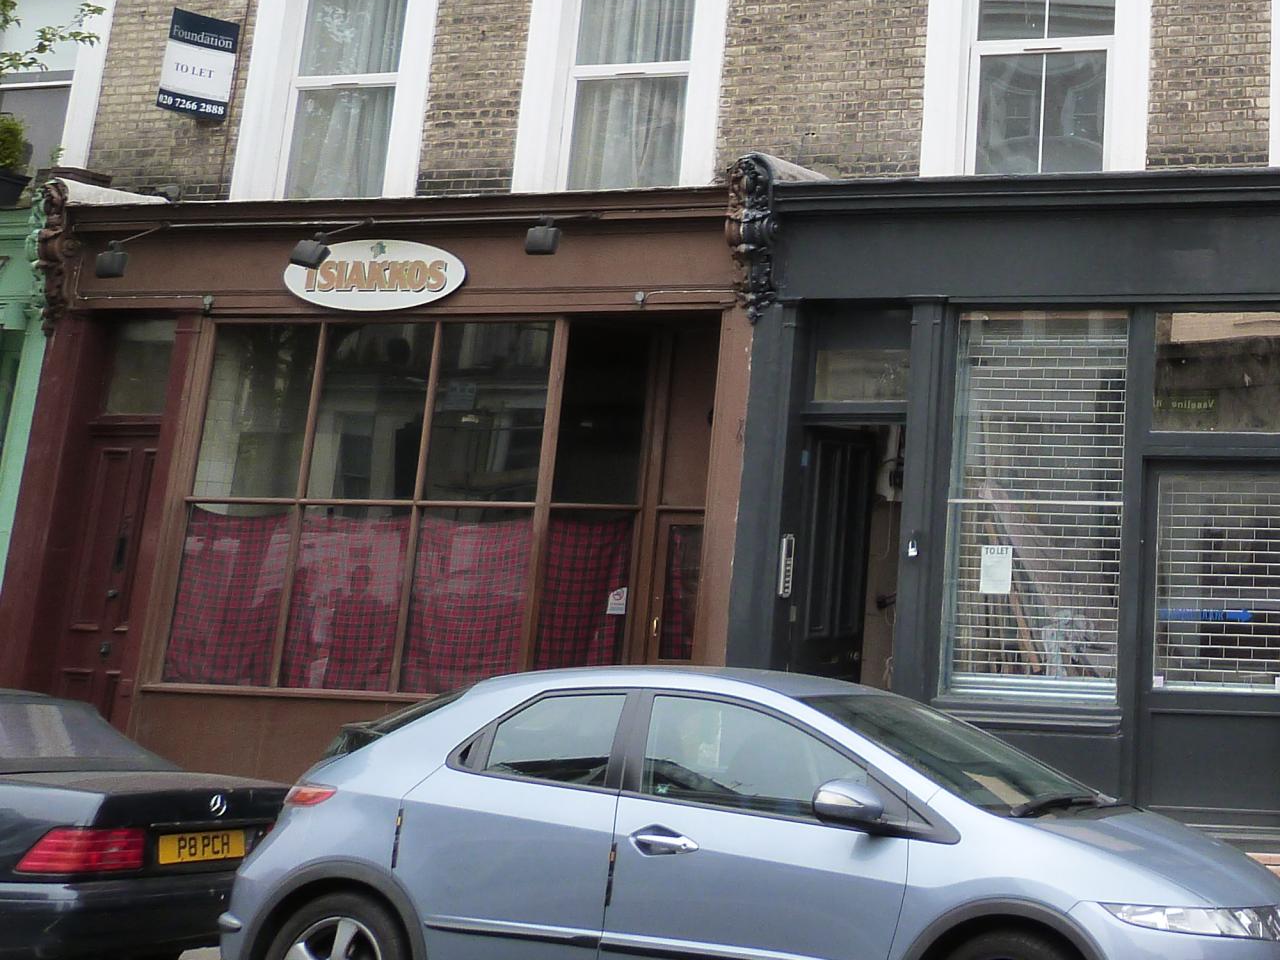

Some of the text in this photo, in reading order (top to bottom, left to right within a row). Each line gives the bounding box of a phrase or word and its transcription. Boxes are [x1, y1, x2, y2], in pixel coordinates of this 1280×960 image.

[172, 25, 233, 49] Foundation
[175, 62, 214, 79] TO LET
[159, 93, 225, 115] 020 7266 2888
[985, 547, 1009, 555] TO LET
[177, 833, 231, 858] P8 PCH
